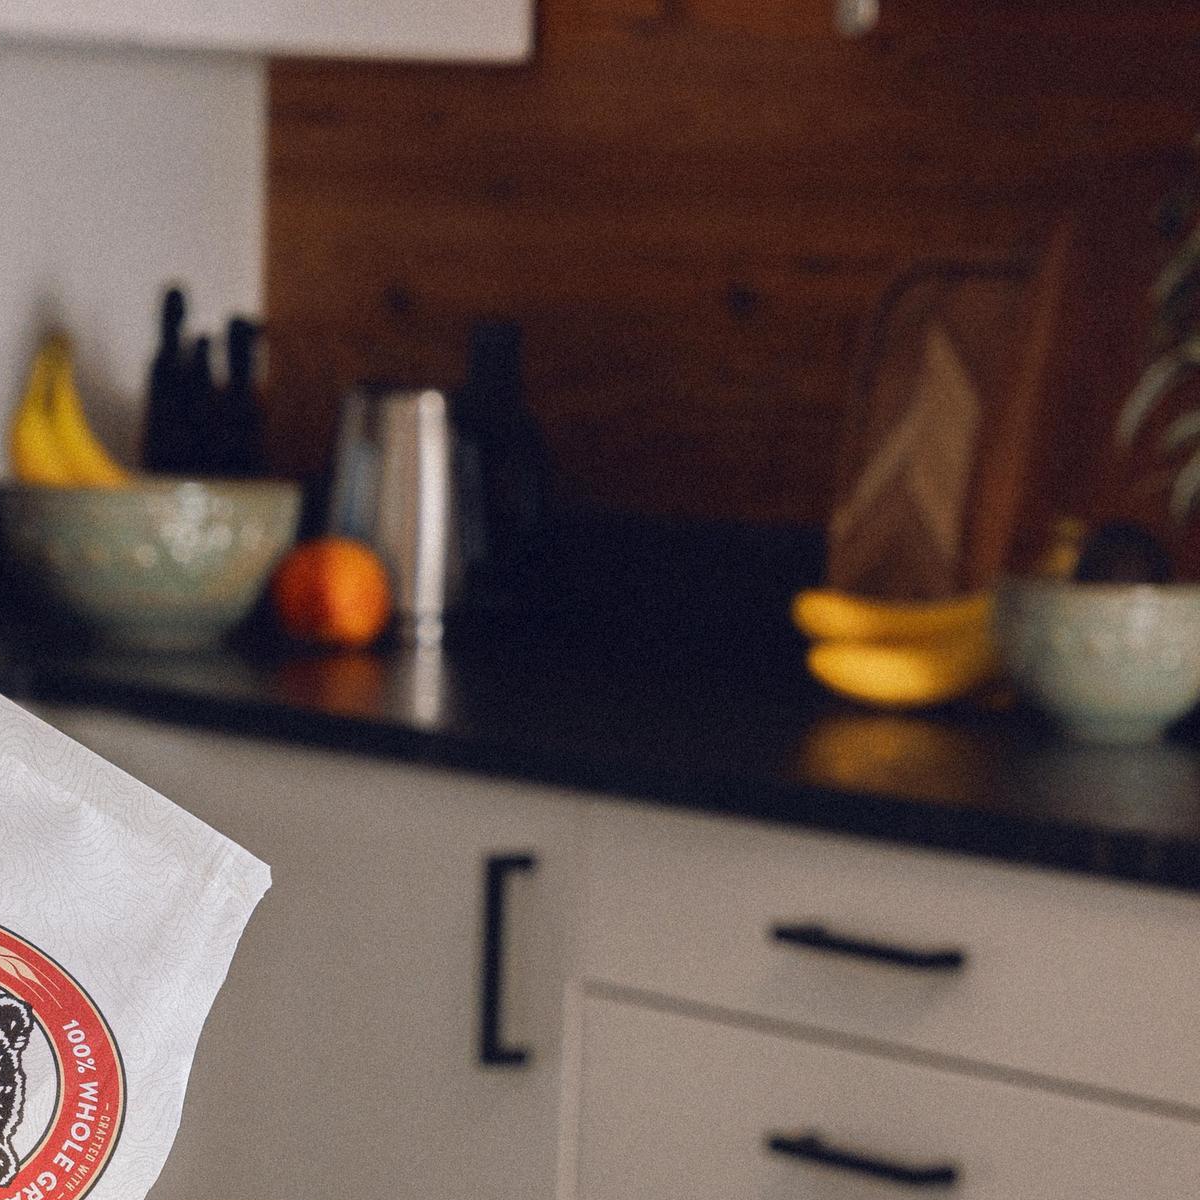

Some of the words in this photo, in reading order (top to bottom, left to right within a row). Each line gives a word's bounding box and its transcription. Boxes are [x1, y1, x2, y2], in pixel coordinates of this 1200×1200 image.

[62, 1020, 96, 1073] 100%
[52, 1081, 98, 1172] WHOLE
[84, 1115, 110, 1162] CRAFTED
[65, 1164, 89, 1191] WITH
